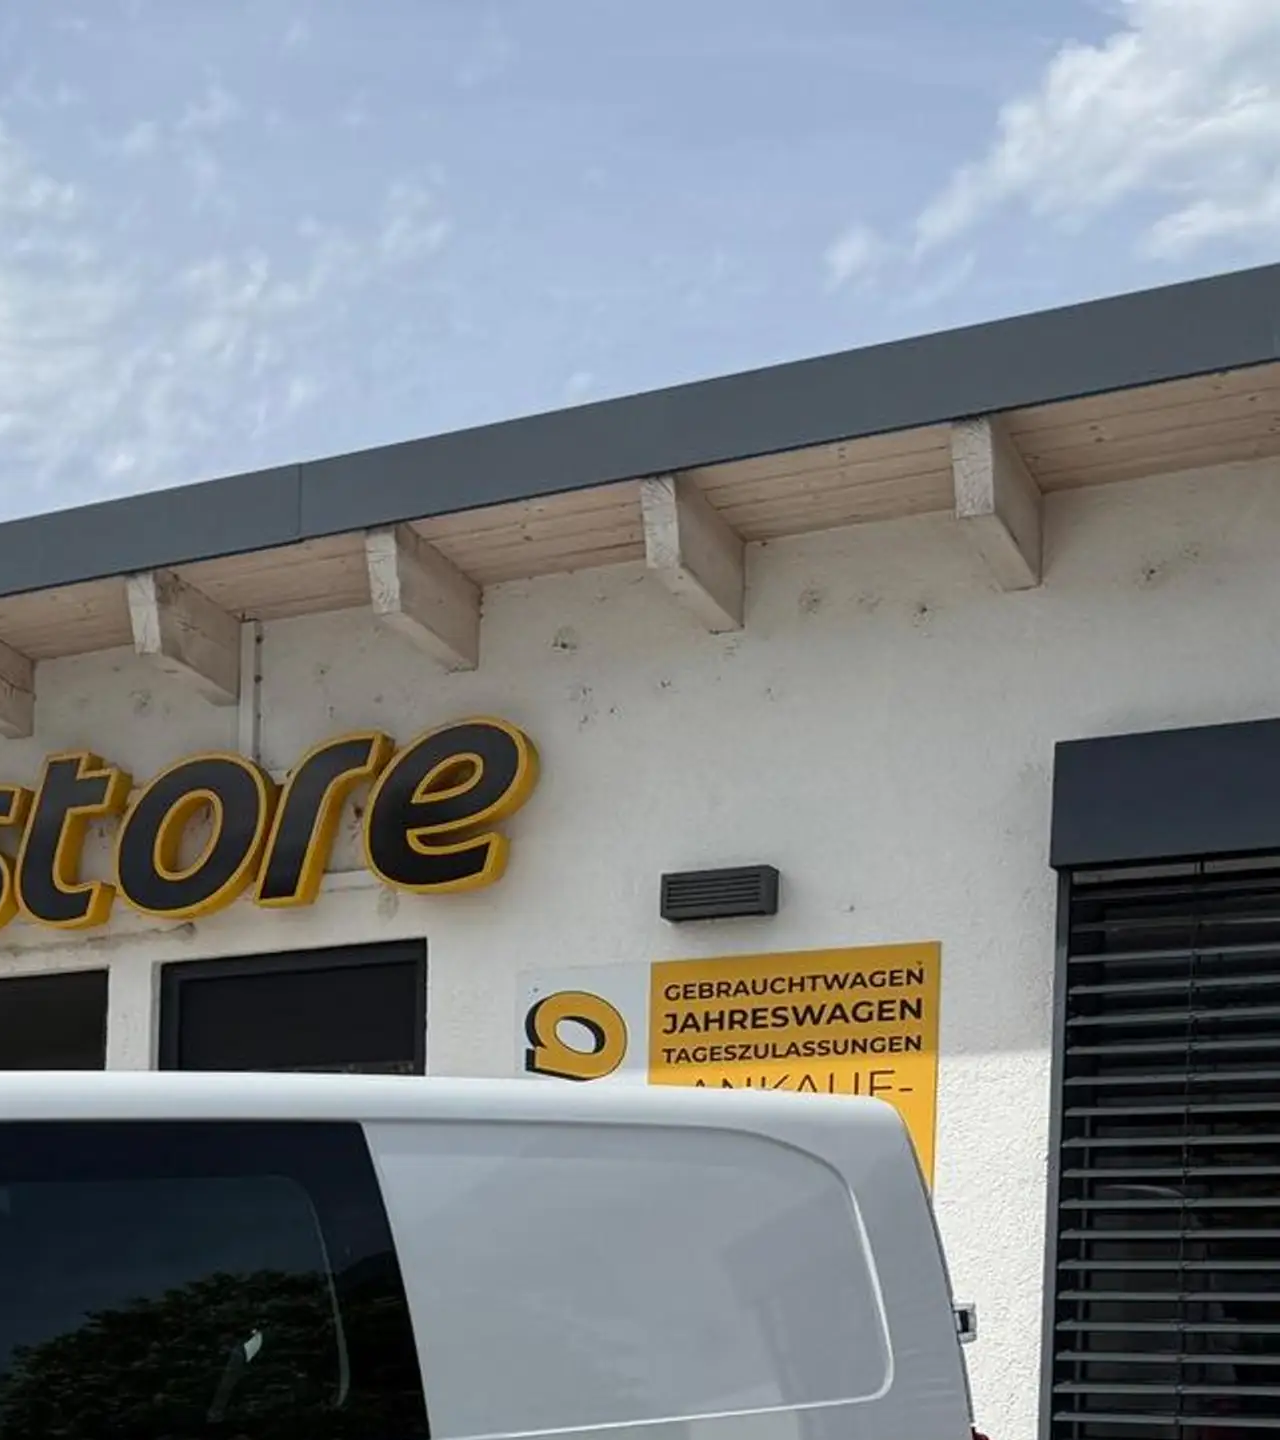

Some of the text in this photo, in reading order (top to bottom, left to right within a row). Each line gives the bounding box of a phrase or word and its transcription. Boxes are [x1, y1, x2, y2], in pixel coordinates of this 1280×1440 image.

[664, 967, 924, 1002] GEBRAUCHTWAGEN
[662, 997, 923, 1035] JAHRESWAGEN
[661, 1034, 923, 1064] TAGESZULASSUNGEN
